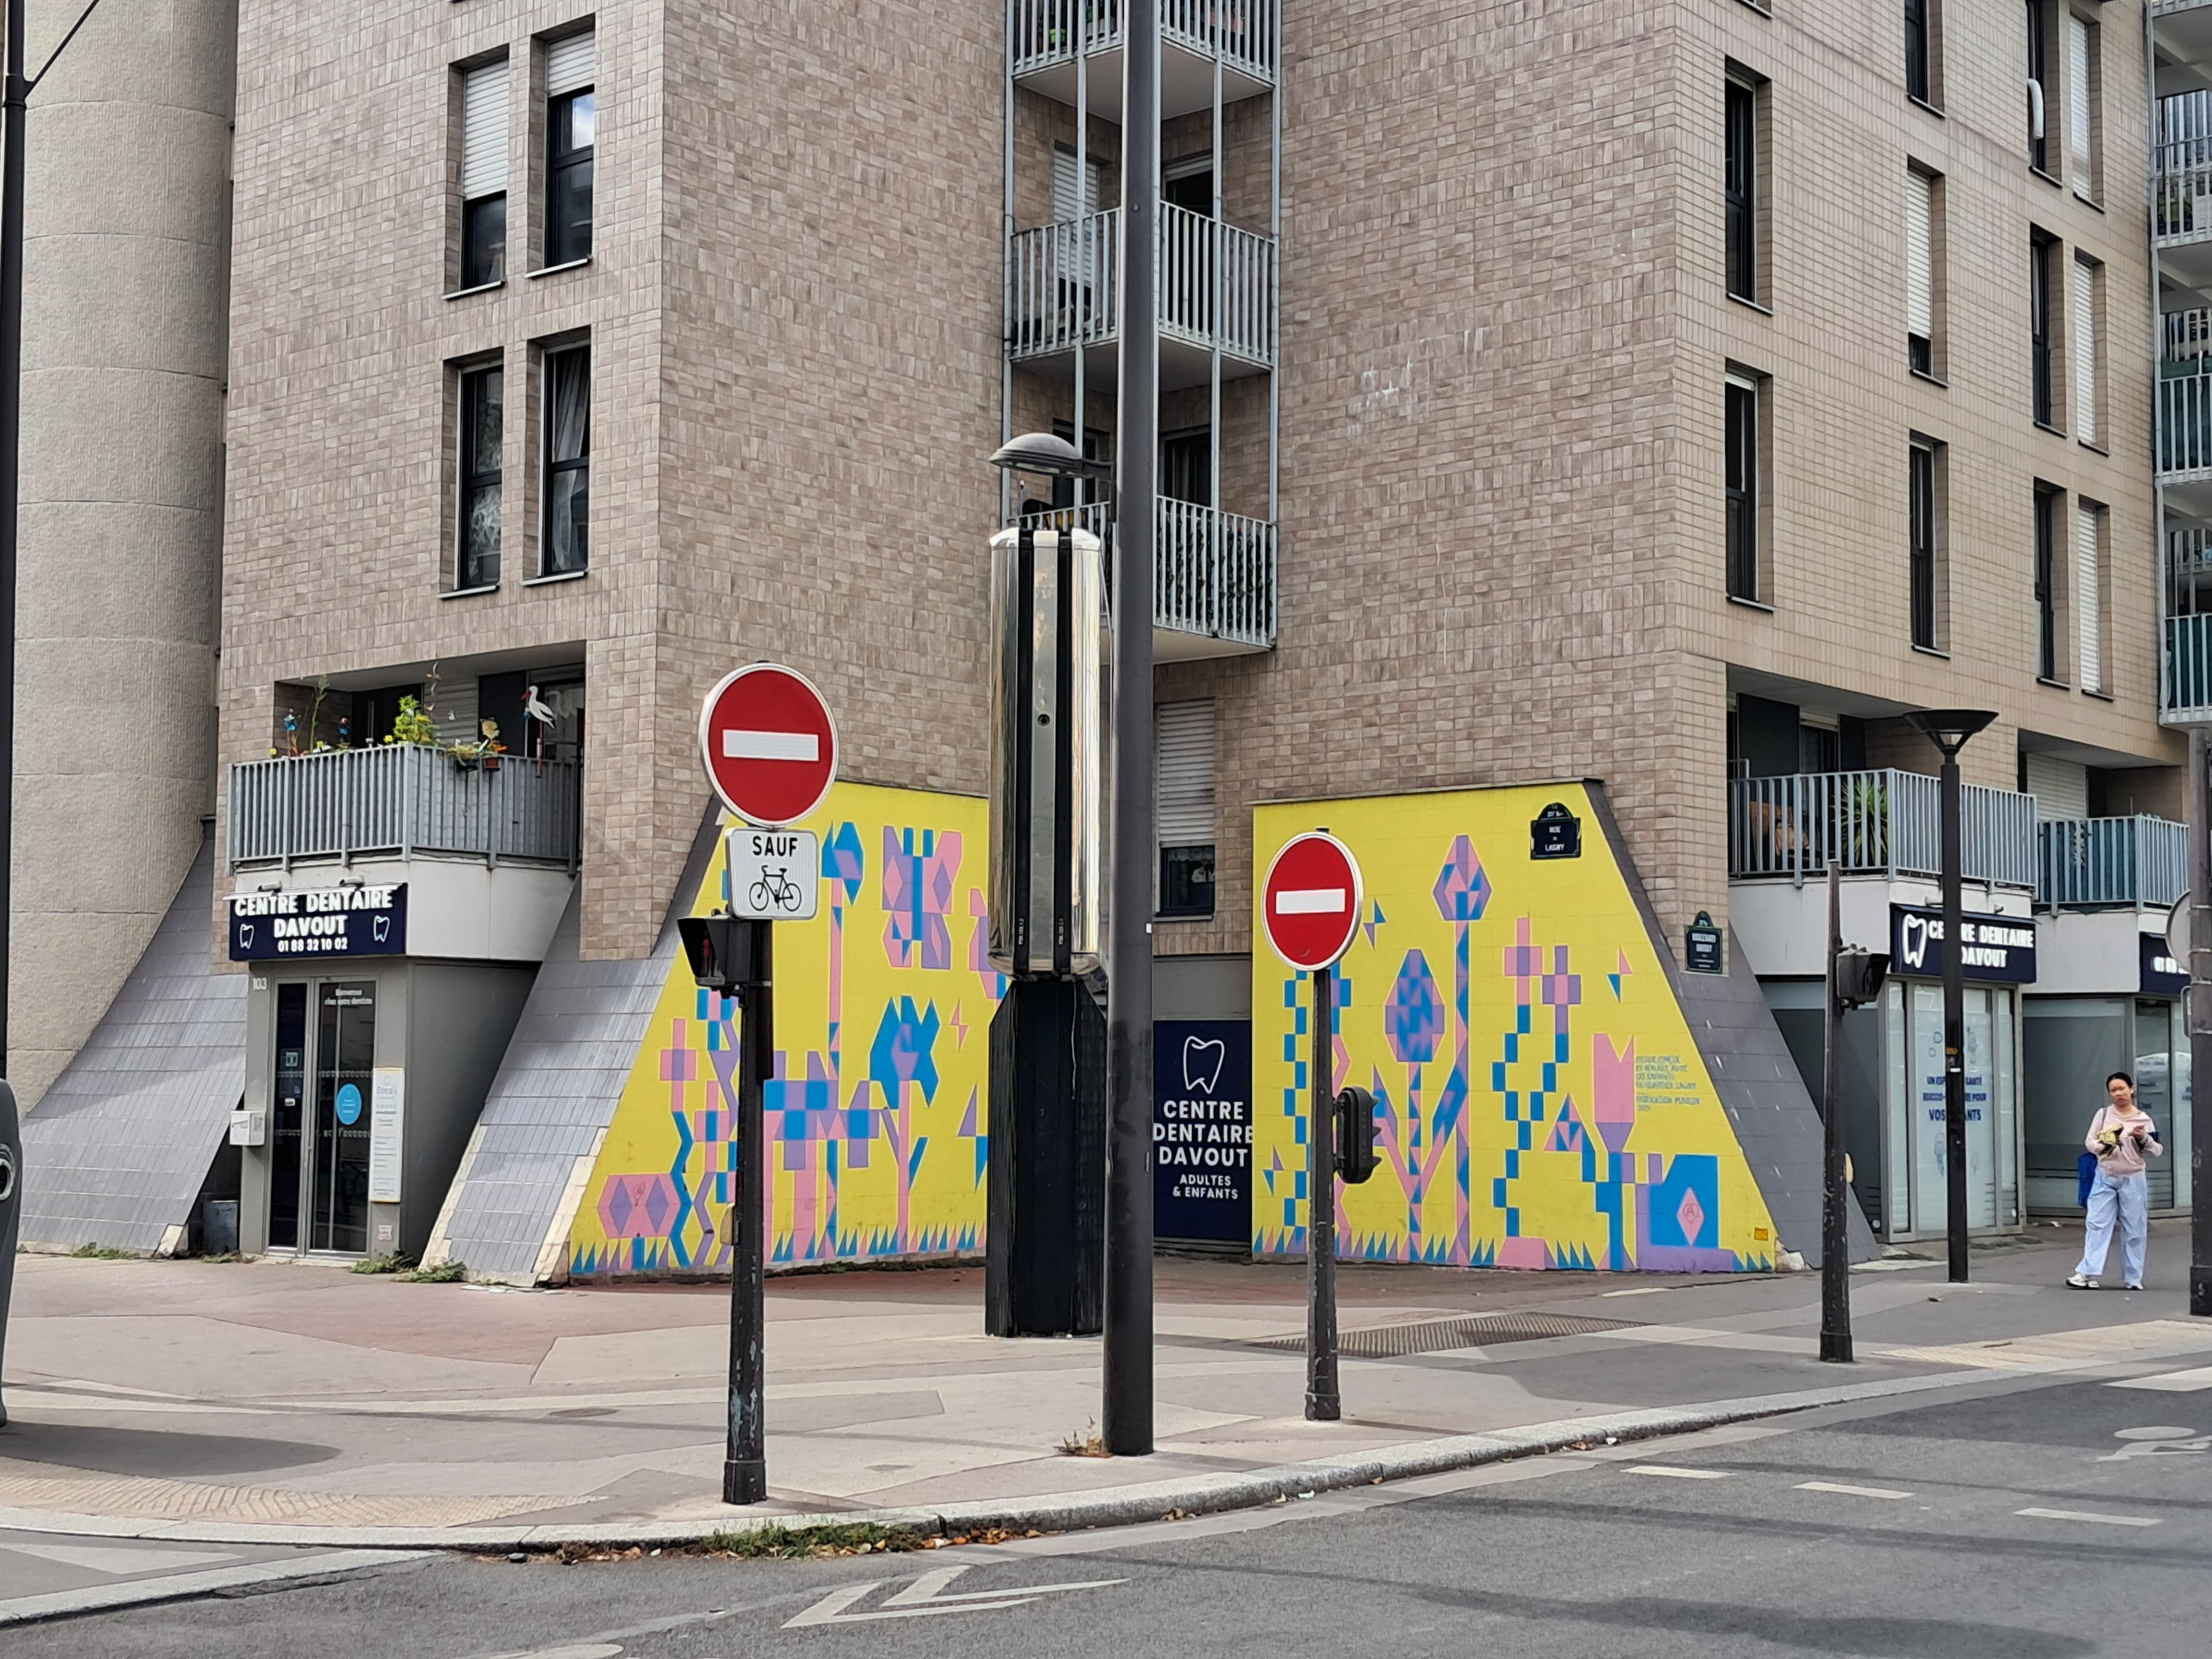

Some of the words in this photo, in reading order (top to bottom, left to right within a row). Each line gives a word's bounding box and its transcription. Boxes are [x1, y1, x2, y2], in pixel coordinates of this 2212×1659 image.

[752, 835, 798, 857] SAUF
[234, 896, 299, 916] CENTRE
[306, 889, 393, 912] DENTAIRE
[274, 915, 348, 938] DAVOUT
[1928, 920, 1975, 942] CERE
[1979, 925, 2033, 948] DENTAIRE
[278, 940, 289, 952] 01
[306, 938, 319, 951] 32
[321, 938, 332, 950] 10
[334, 937, 348, 950] 02
[252, 977, 267, 990] 103
[1164, 1100, 1244, 1120] CENTRE
[1929, 1109, 1946, 1121] VOS
[1153, 1123, 1253, 1143] DENTAIRE
[1159, 1146, 1248, 1167] DAVOUT
[1180, 1173, 1231, 1186] ADULTES
[1172, 1186, 1181, 1197] &
[1185, 1187, 1238, 1199] ENFANTS
